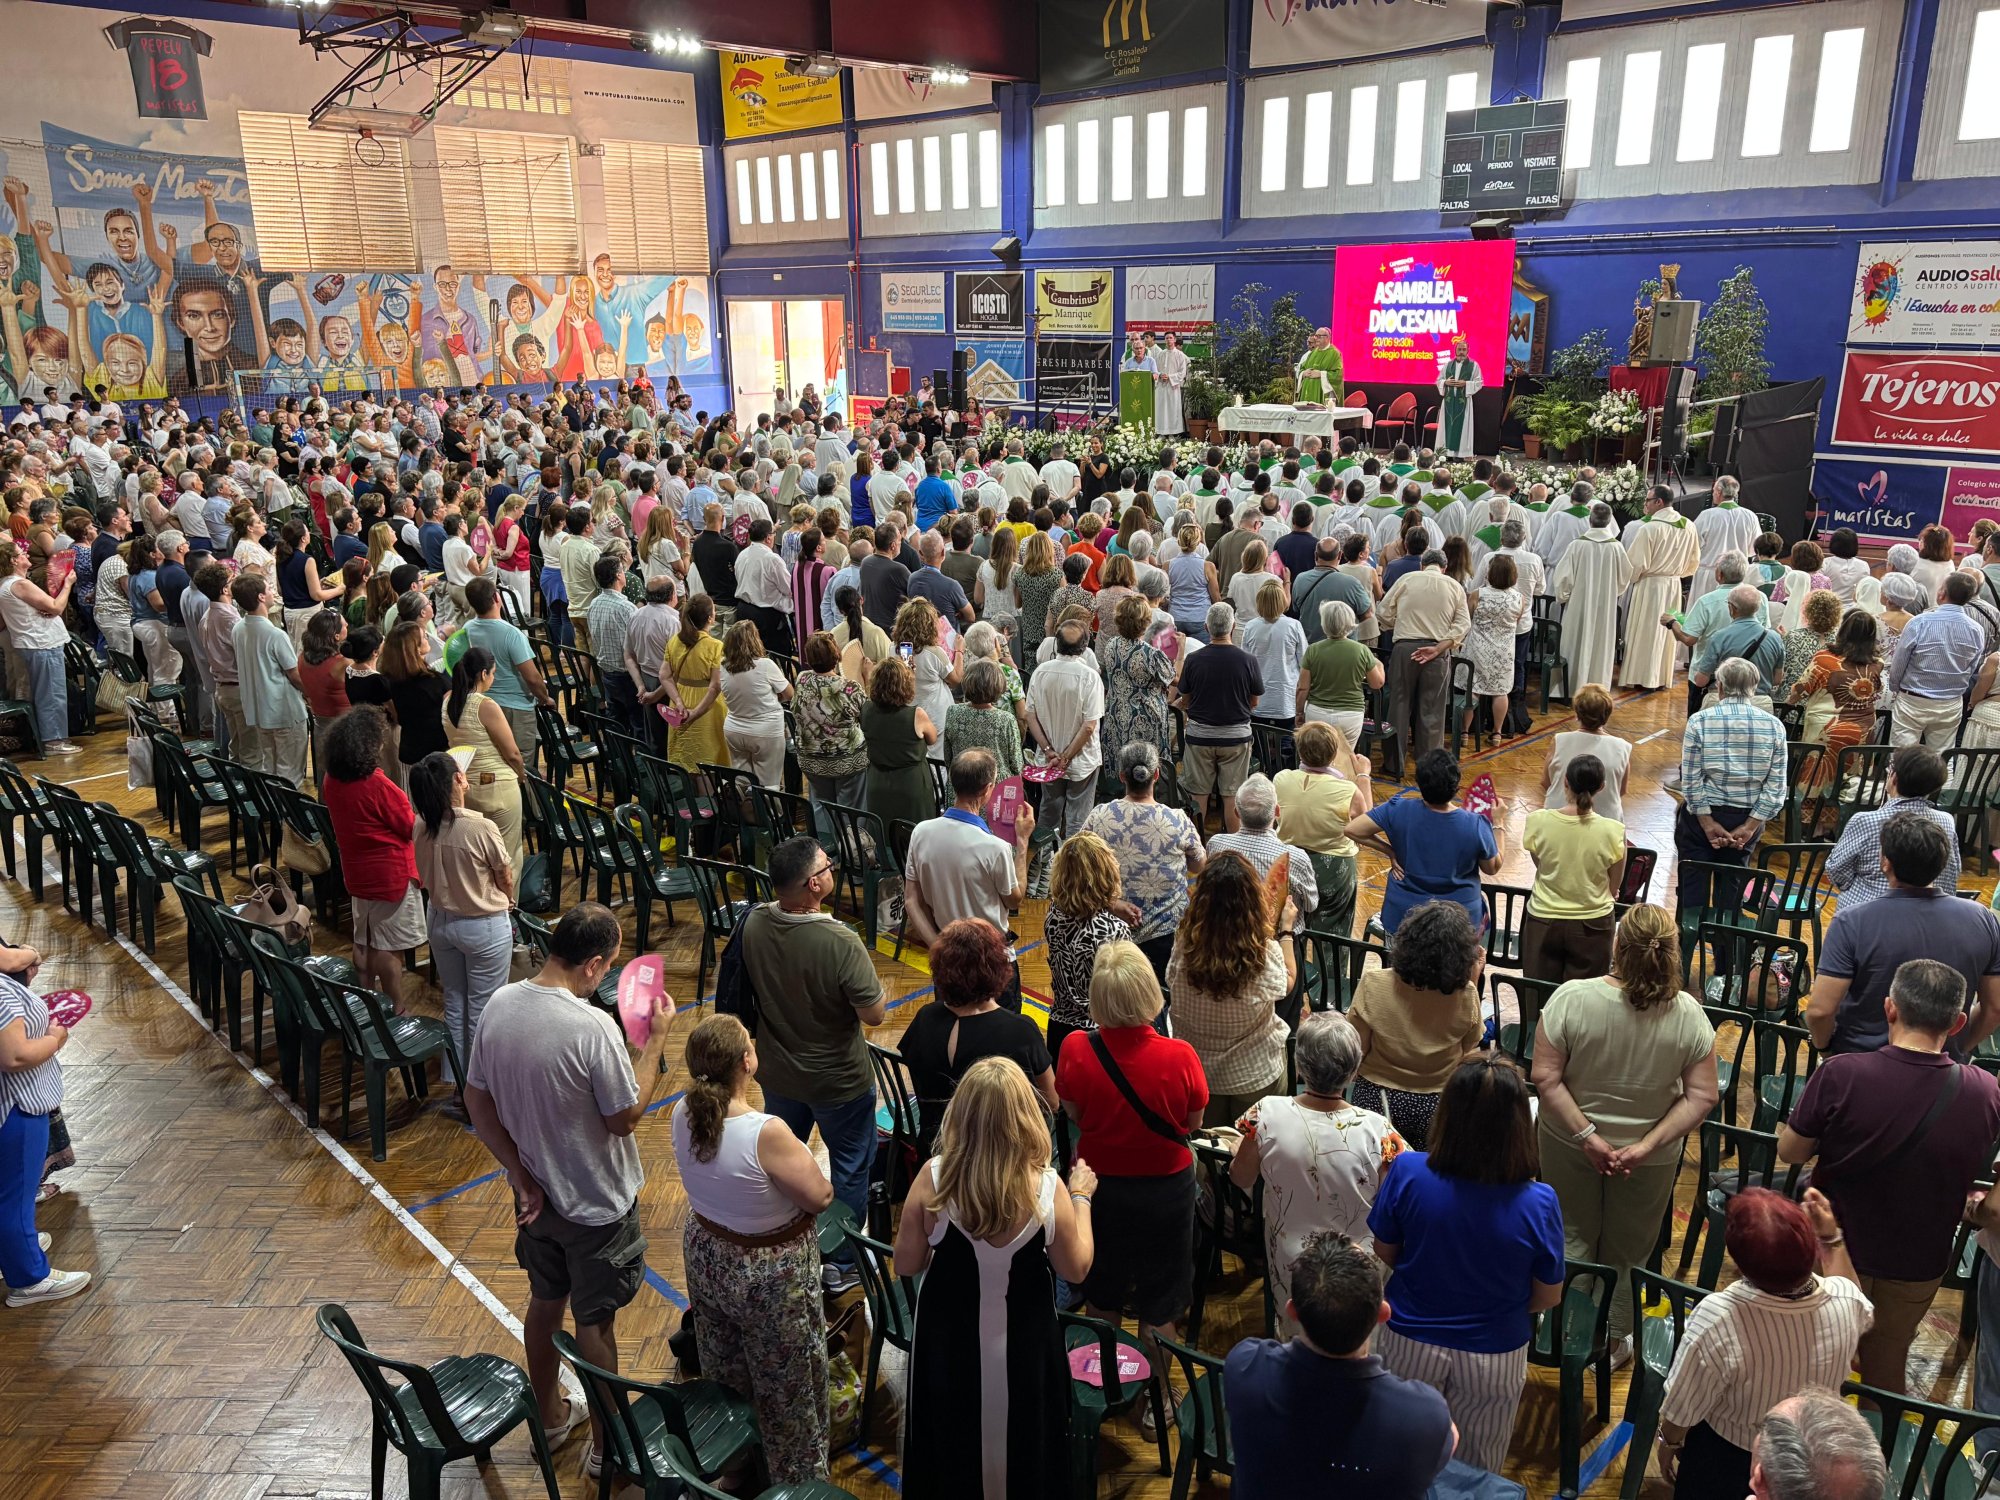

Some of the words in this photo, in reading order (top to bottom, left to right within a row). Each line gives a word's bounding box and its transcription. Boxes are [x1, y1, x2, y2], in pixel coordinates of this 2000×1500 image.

[1118, 45, 1148, 58] Rosaleda
[149, 58, 188, 97] 18
[1113, 65, 1140, 77] Carlinda
[1452, 163, 1472, 173] LOCAL
[1487, 161, 1514, 170] PERIODO
[1523, 156, 1557, 168] VISITANTE
[1440, 200, 1470, 210] FALTAS
[1525, 194, 1558, 205] FALTAS
[1050, 292, 1098, 305] Gambrinus
[1374, 281, 1455, 304] ASAMBLEA
[972, 293, 1007, 314] ACOSTA
[1960, 304, 1977, 314] en
[1055, 308, 1093, 321] Manrique
[1369, 308, 1458, 334] DIOCESANA
[1372, 337, 1393, 347] 20/06
[1393, 337, 1414, 347] 9:30h
[1371, 349, 1400, 361] Colegio
[1401, 349, 1434, 360] Maristas
[1071, 358, 1111, 369] BARBER
[1859, 371, 2000, 412] Tejeros
[1874, 426, 1887, 439] La
[1891, 428, 1918, 441] vida
[1922, 433, 1934, 442] es
[1937, 429, 1971, 443] dulce
[1957, 479, 1987, 488] Colegio
[1834, 507, 1916, 529] maristas
